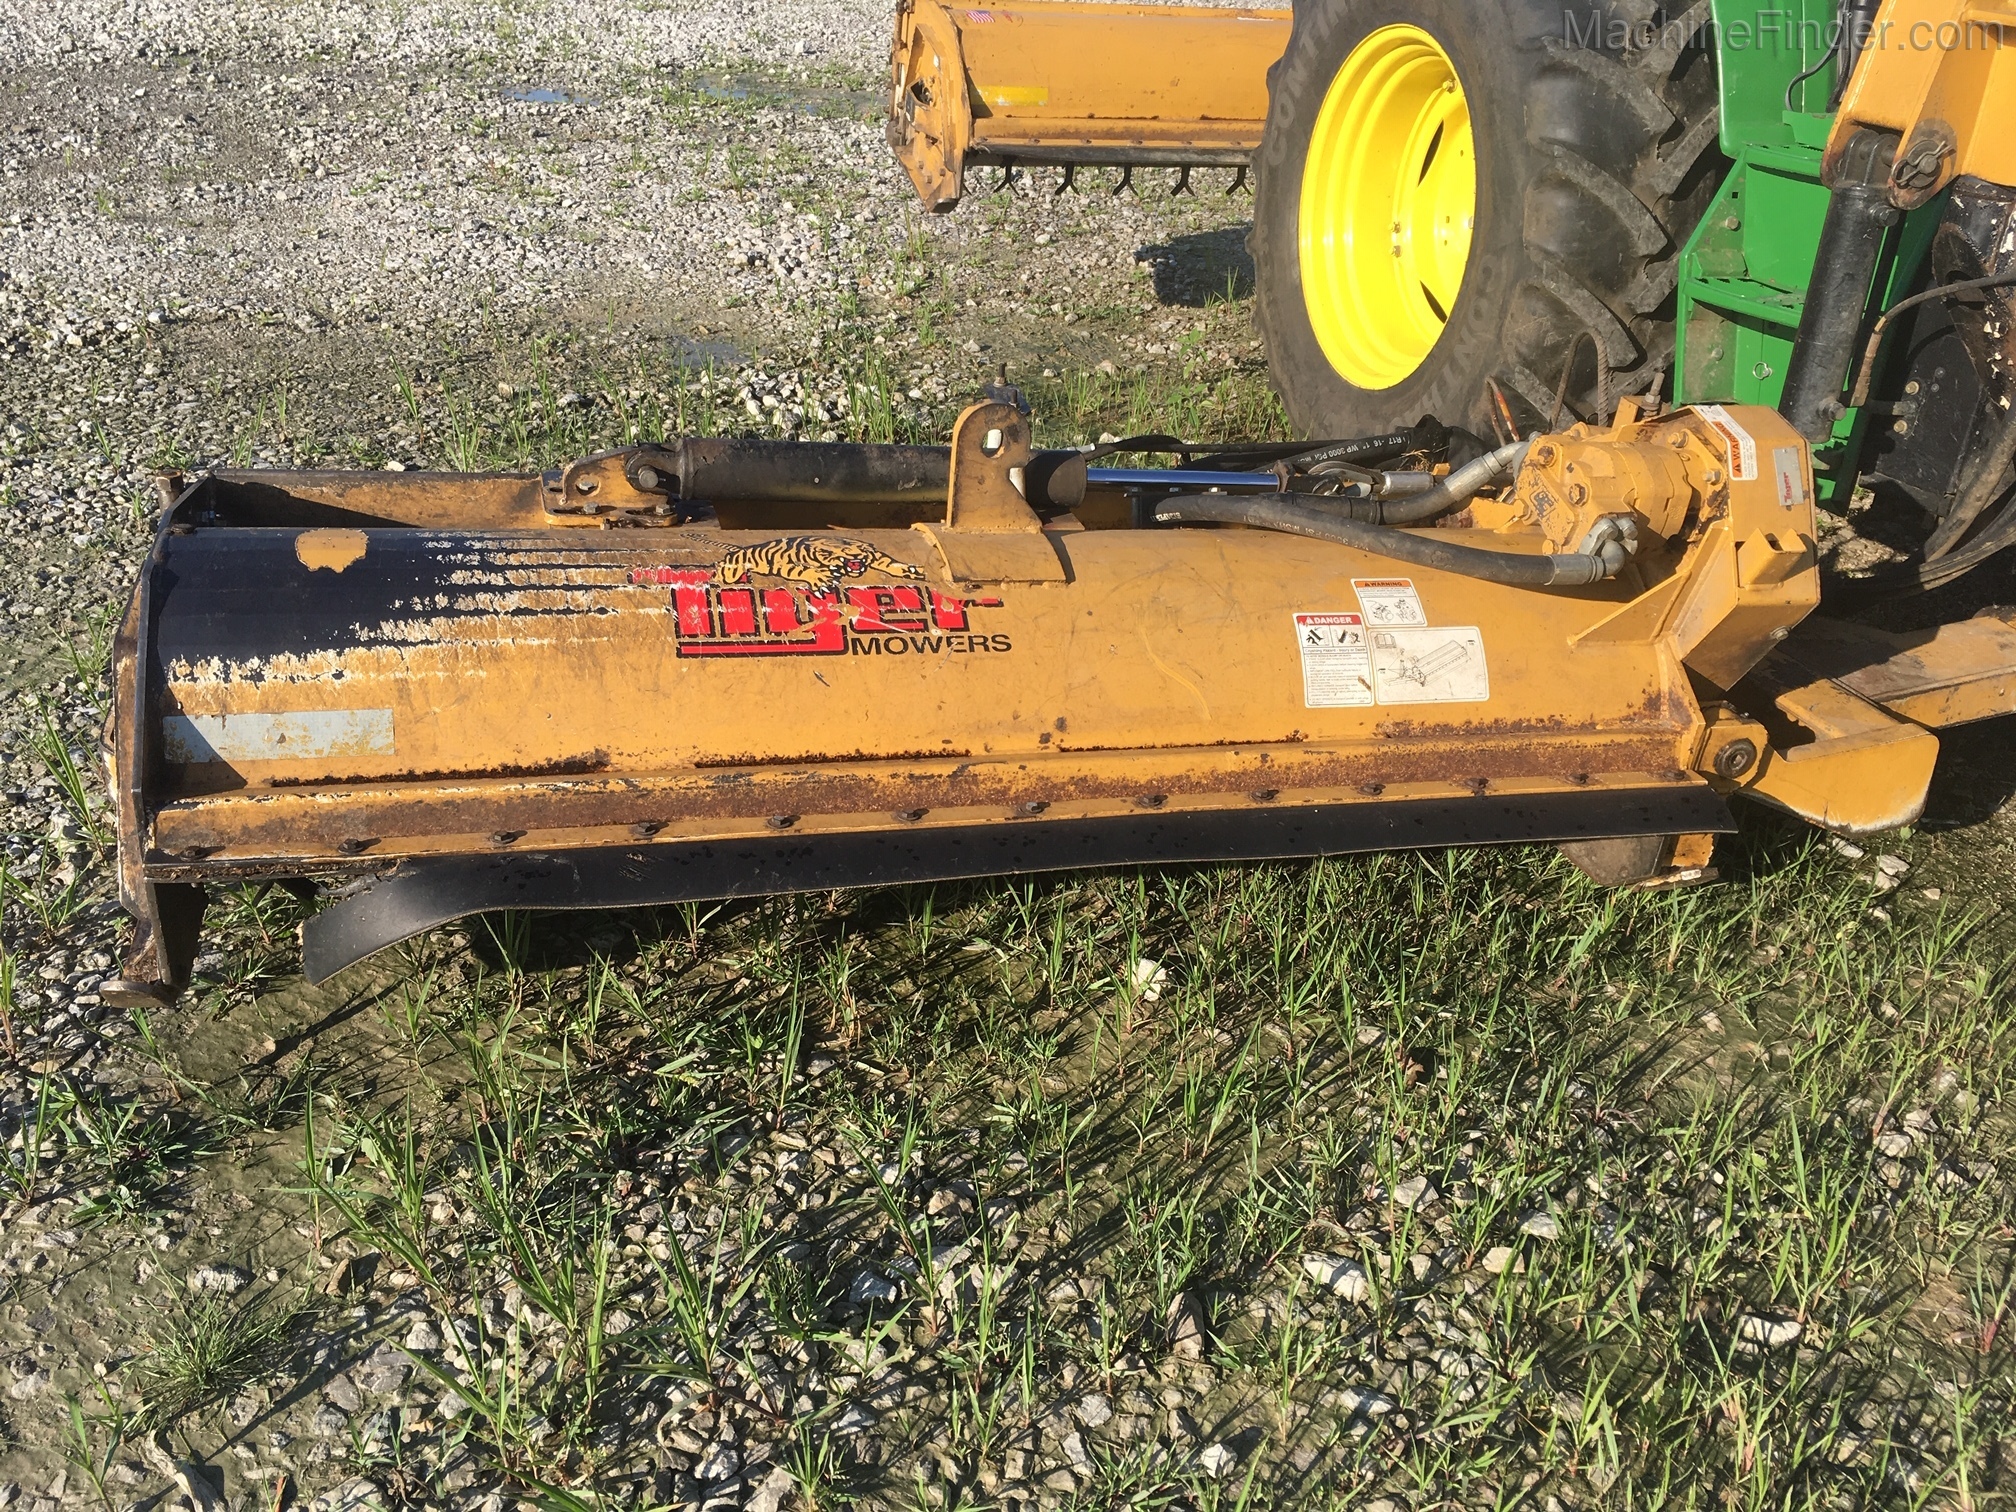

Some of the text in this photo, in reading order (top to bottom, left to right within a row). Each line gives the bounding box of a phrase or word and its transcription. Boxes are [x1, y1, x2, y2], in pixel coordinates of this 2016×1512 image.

[1328, 447, 1346, 457] 3000
[1313, 616, 1353, 625] DANGER
[848, 633, 1013, 656] MOWERS
